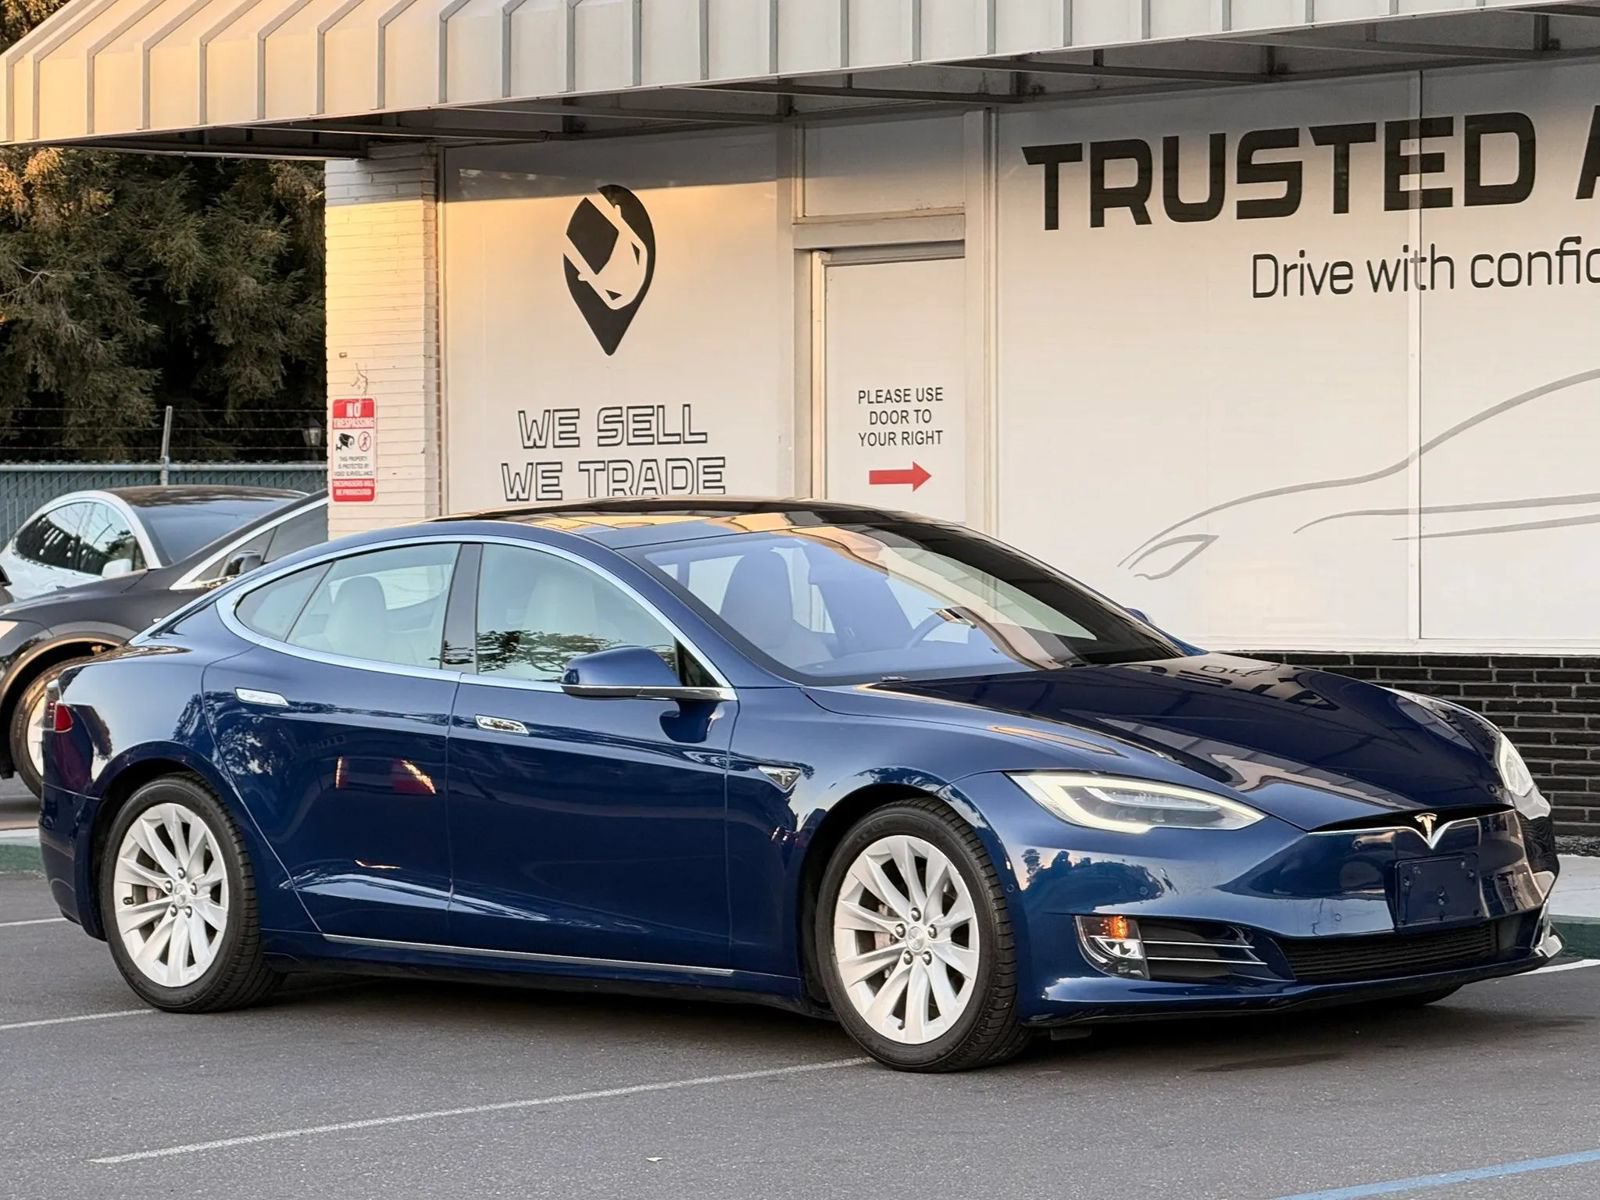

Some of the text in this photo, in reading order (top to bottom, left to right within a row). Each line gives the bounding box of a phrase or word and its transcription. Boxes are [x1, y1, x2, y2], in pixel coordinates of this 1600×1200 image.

[1021, 112, 1536, 231] TRUSTED
[1253, 250, 1354, 299] Drive
[1366, 243, 1455, 292] with
[346, 402, 361, 418] NO
[858, 387, 944, 404] PLEASE USE
[518, 404, 708, 449] WE SELL
[869, 408, 932, 425] DOOR TO
[858, 430, 943, 447] YOUR RIGHT
[501, 456, 726, 502] WE TRADE
